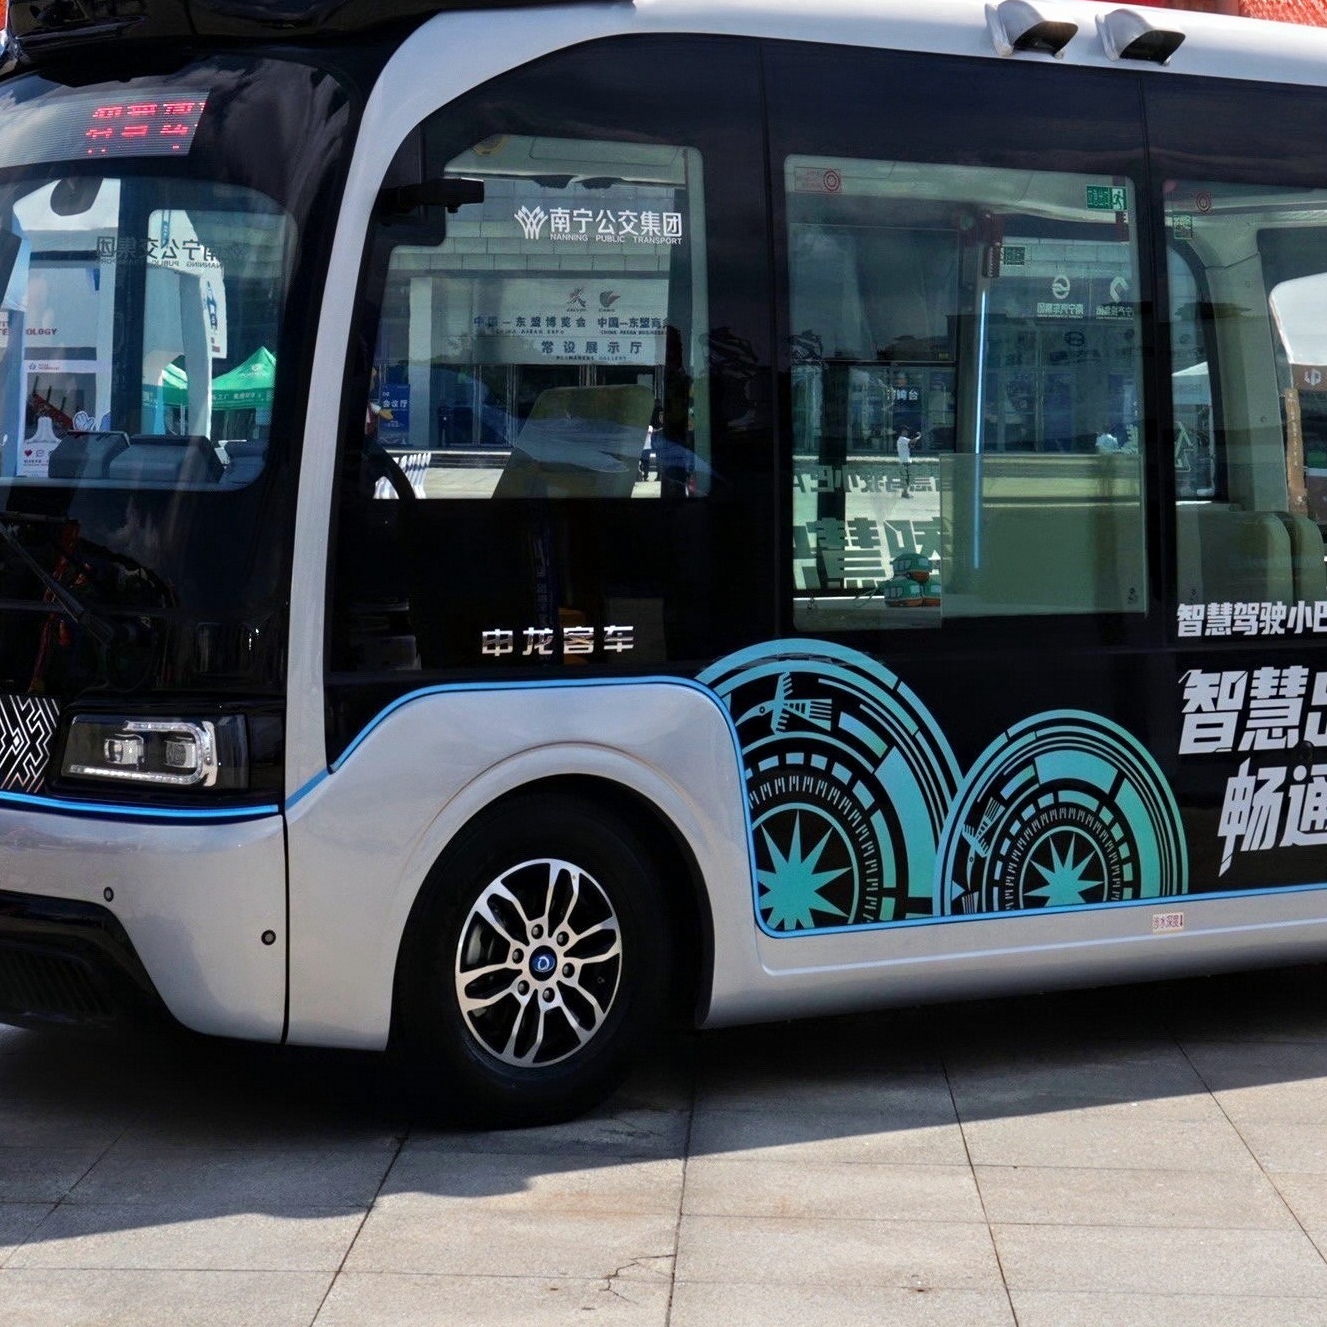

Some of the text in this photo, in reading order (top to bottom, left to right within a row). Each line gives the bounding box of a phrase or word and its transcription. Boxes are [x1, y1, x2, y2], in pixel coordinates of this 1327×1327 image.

[550, 207, 682, 237] 南宁公交集团
[550, 233, 682, 245] NANNING PUBLIC TRANSPORT
[541, 340, 642, 355] 常设展示厅
[481, 625, 634, 657] 申龙客车
